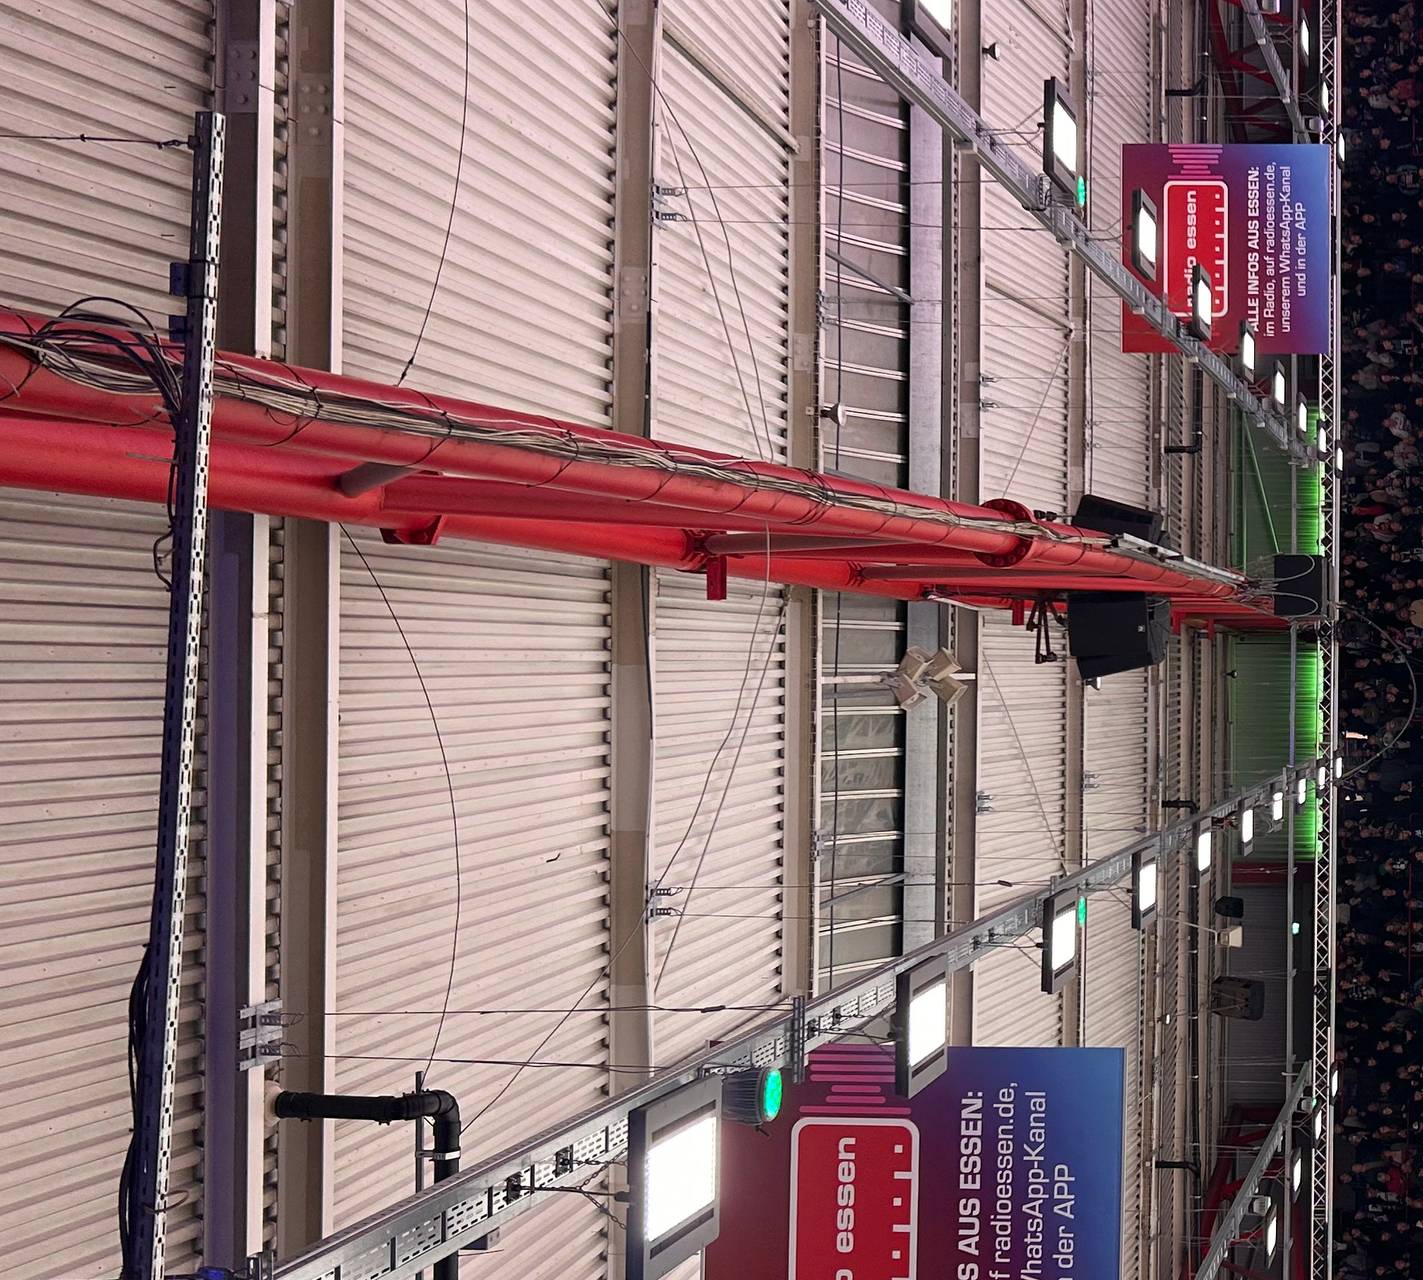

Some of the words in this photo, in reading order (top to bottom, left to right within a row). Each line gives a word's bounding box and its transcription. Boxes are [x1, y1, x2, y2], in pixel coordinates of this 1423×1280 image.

[1248, 166, 1260, 217] ESSEN:
[1263, 161, 1277, 253] radioessen.de,
[1186, 190, 1197, 249] essen
[1248, 220, 1260, 249] AUS
[1279, 166, 1295, 273] WhatsApp-Kanal
[1295, 202, 1307, 230] APP
[1295, 233, 1307, 255] der
[1295, 259, 1307, 270] in
[1248, 252, 1260, 294] INFOS
[1263, 255, 1275, 276] auf
[1295, 273, 1307, 296] und
[1248, 298, 1259, 331] ALLE
[1263, 279, 1277, 318] Radio,
[1281, 277, 1291, 332] unserem
[1264, 321, 1275, 336] im
[960, 1091, 983, 1189] ESSEN:
[990, 1082, 1017, 1262] radioessen.de,
[1054, 1164, 1075, 1219] APP
[837, 1137, 856, 1253] essen
[958, 1198, 980, 1255] AUS
[1052, 1226, 1074, 1268] der
